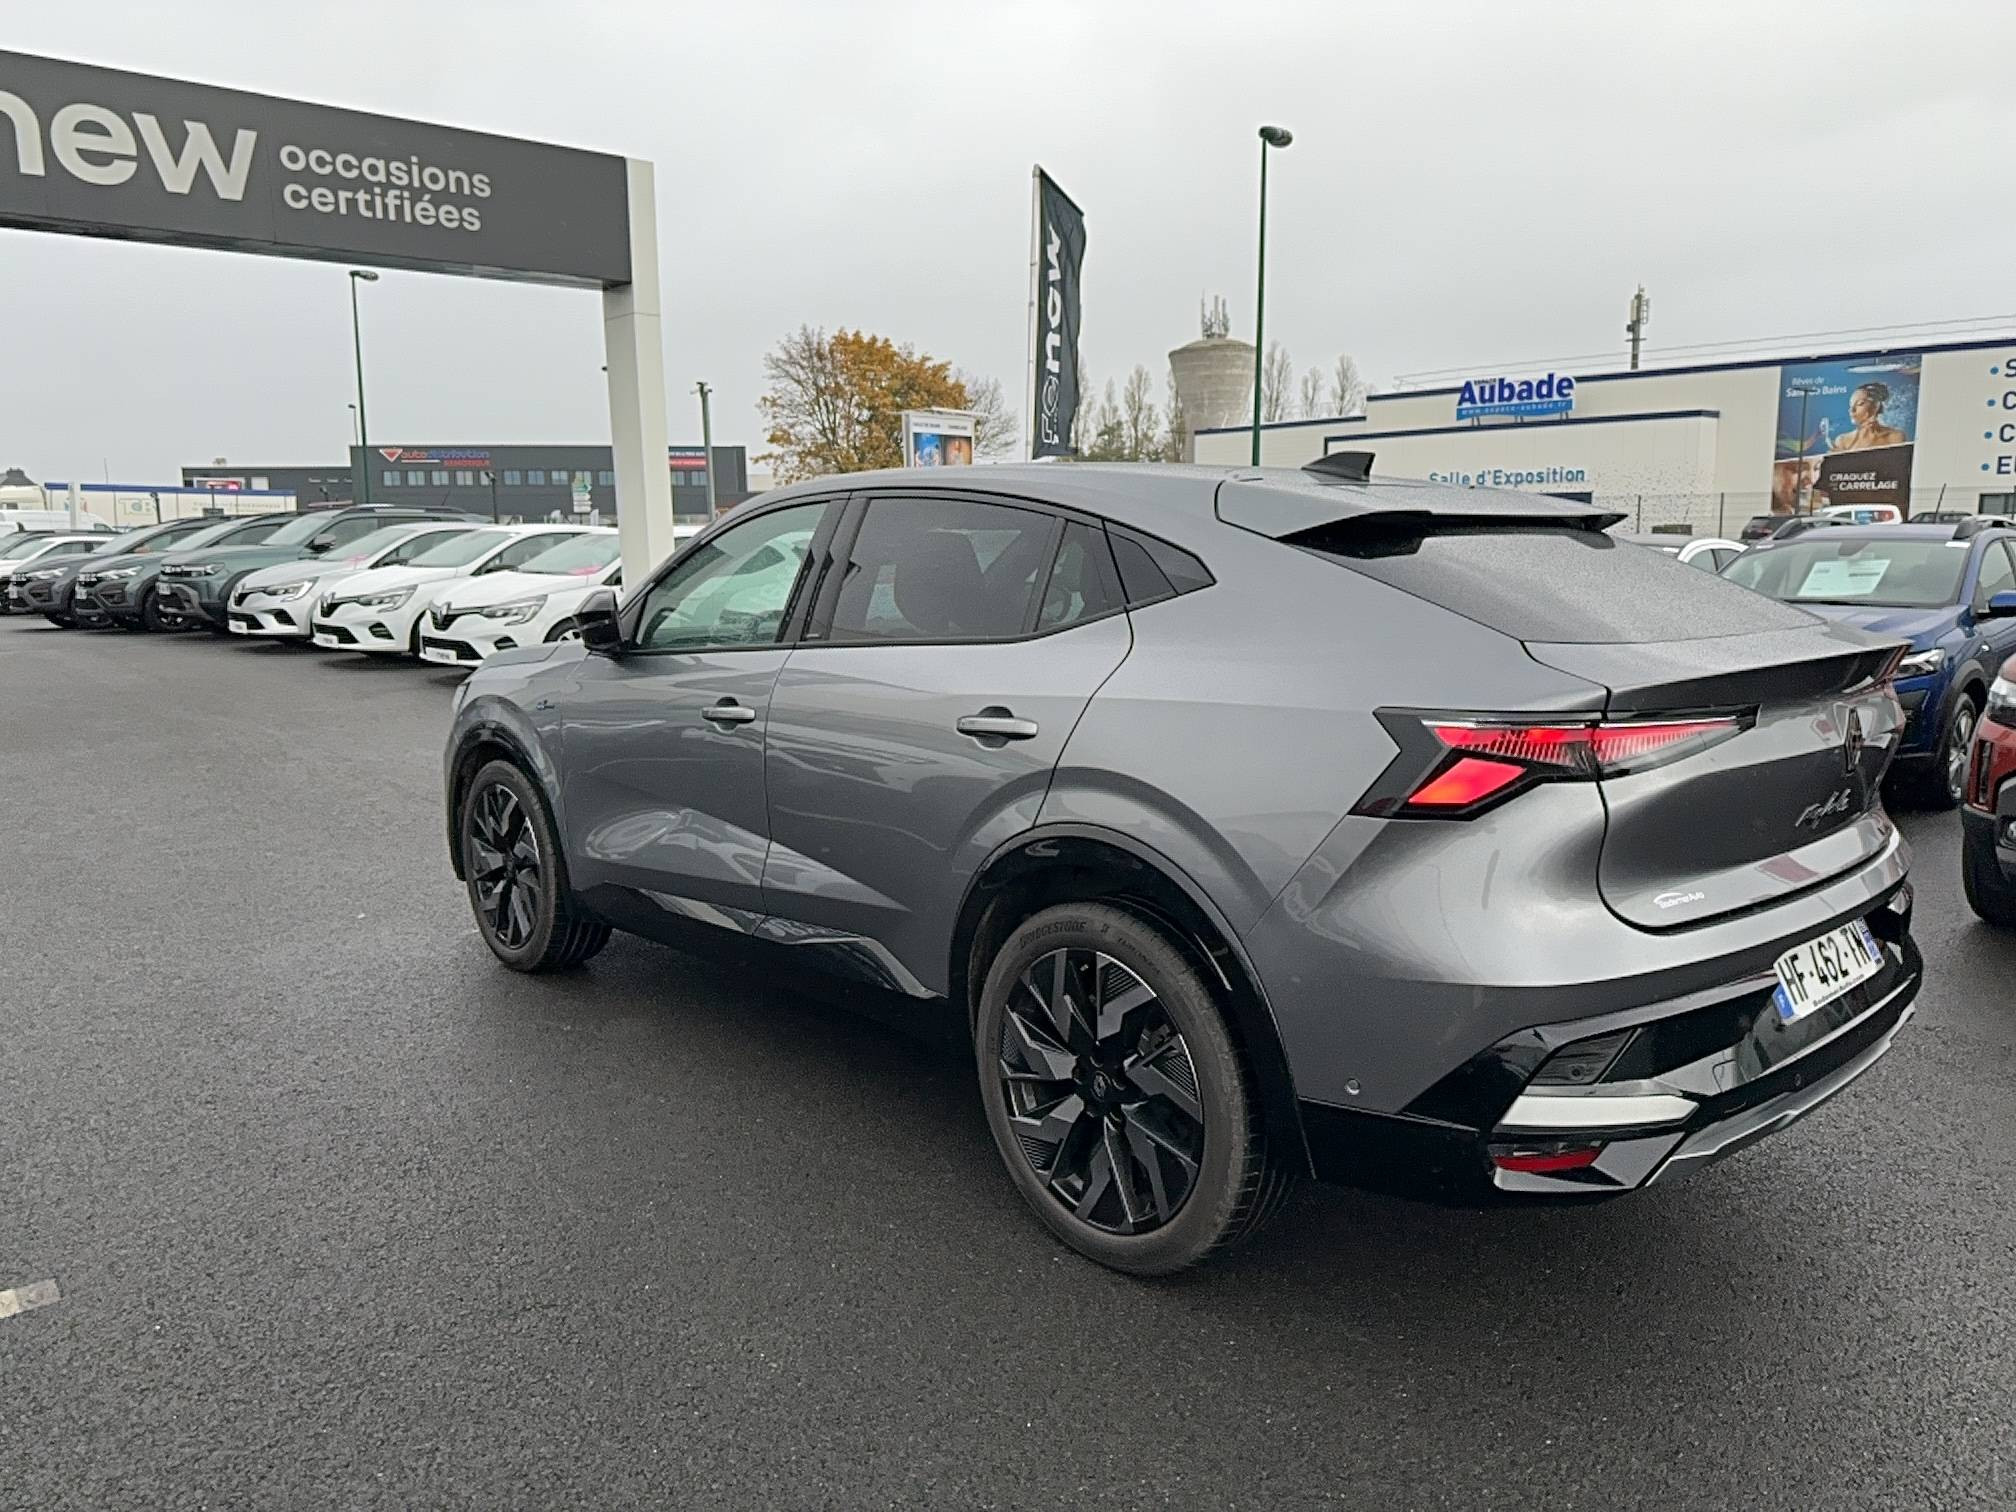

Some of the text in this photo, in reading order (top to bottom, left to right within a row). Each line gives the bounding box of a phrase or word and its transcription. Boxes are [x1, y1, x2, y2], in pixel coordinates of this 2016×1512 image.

[279, 144, 493, 198] occasions
[283, 181, 484, 232] certifiées
[1457, 372, 1575, 406] Aubade
[1822, 385, 1847, 395] Bains
[1476, 466, 1585, 487] d'Exposition
[1829, 472, 1876, 482] CRAQUEZ
[1838, 481, 1899, 491] CARRELAGE
